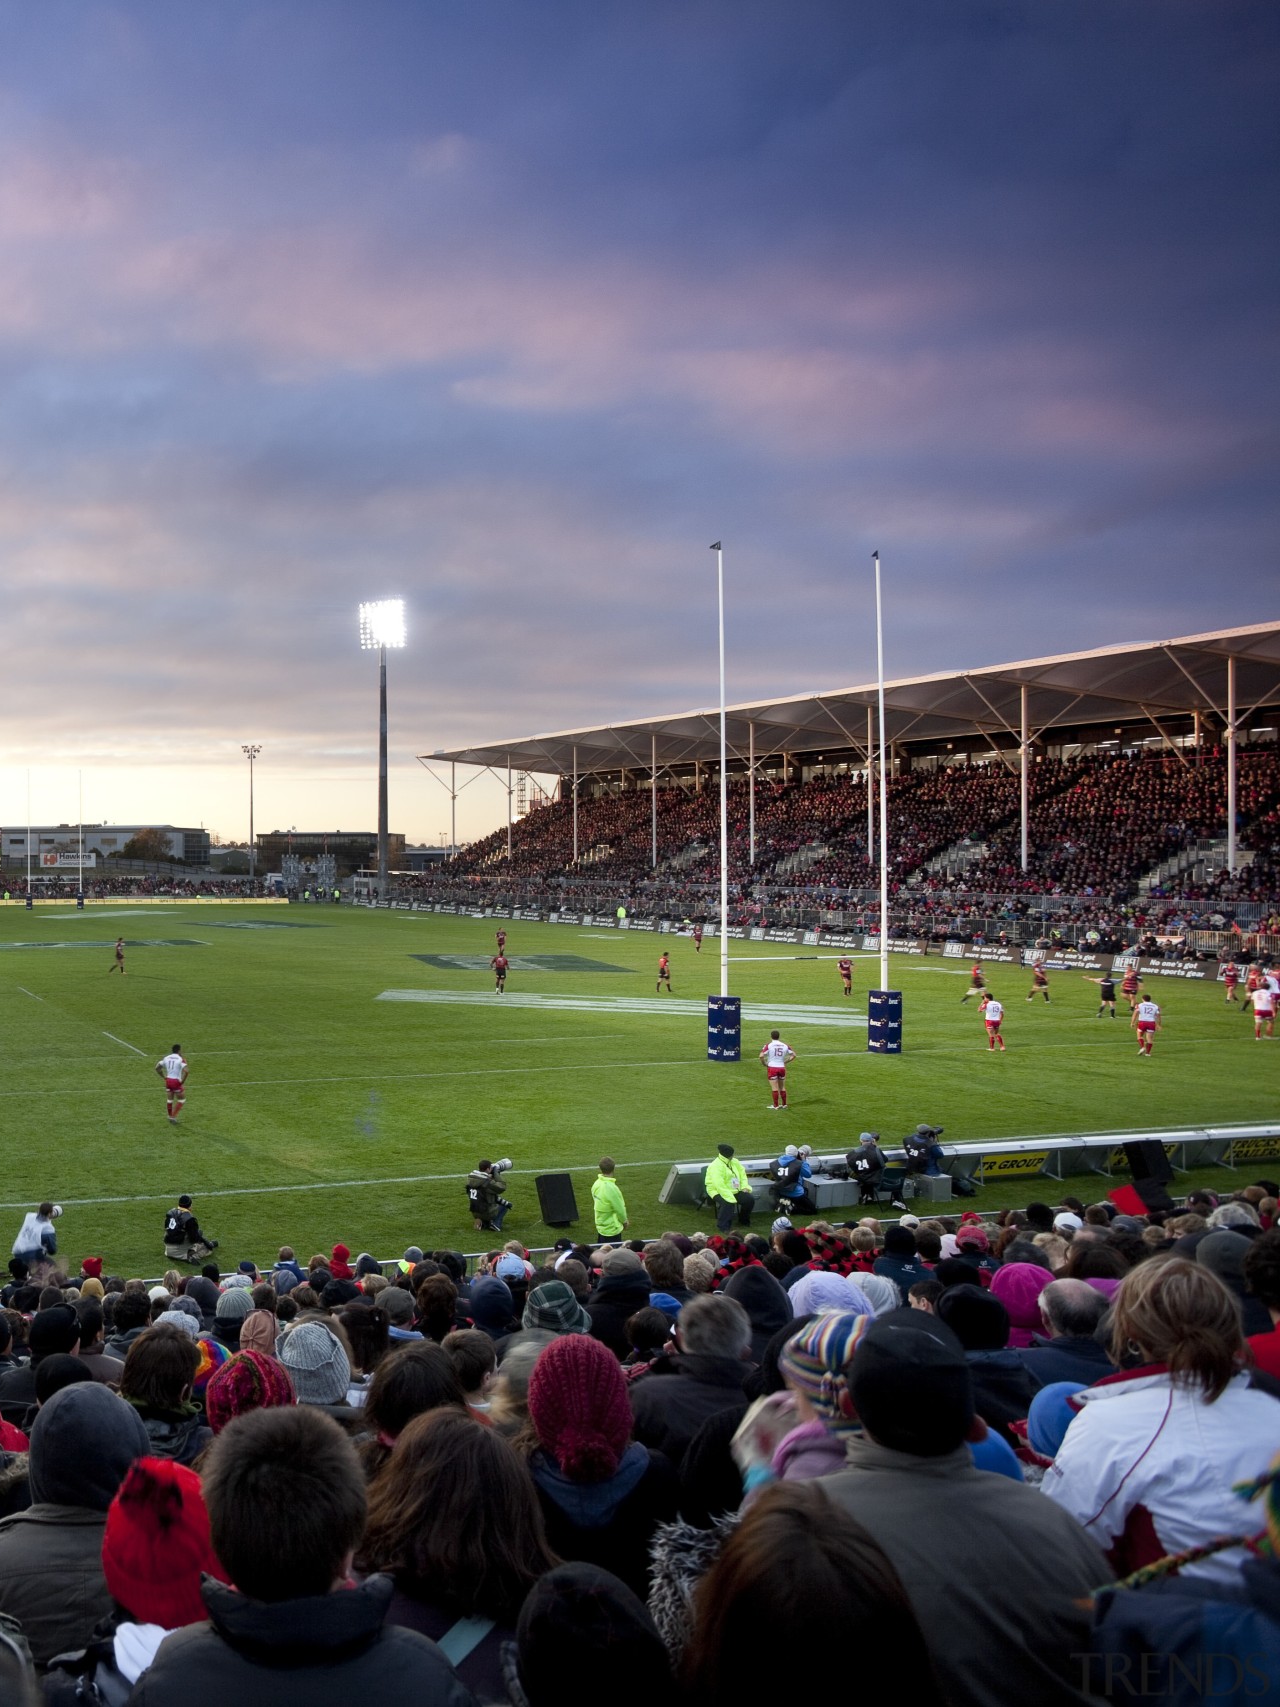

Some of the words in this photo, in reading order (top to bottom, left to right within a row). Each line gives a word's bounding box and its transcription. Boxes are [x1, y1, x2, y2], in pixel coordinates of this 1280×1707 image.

[1082, 954, 1096, 962] got
[1183, 962, 1198, 970] got
[1160, 968, 1186, 976] sports
[1185, 970, 1206, 978] gear
[723, 1003, 736, 1011] bnz
[992, 1005, 1000, 1013] 13
[1144, 1006, 1154, 1015] 12
[723, 1027, 736, 1035] bnz
[723, 1049, 735, 1057] bnz
[774, 1047, 784, 1057] 15
[168, 1060, 175, 1070] 11
[855, 1159, 870, 1171] 24
[998, 1157, 1045, 1170] GROUP
[777, 1167, 789, 1177] 31
[469, 1188, 478, 1200] 12
